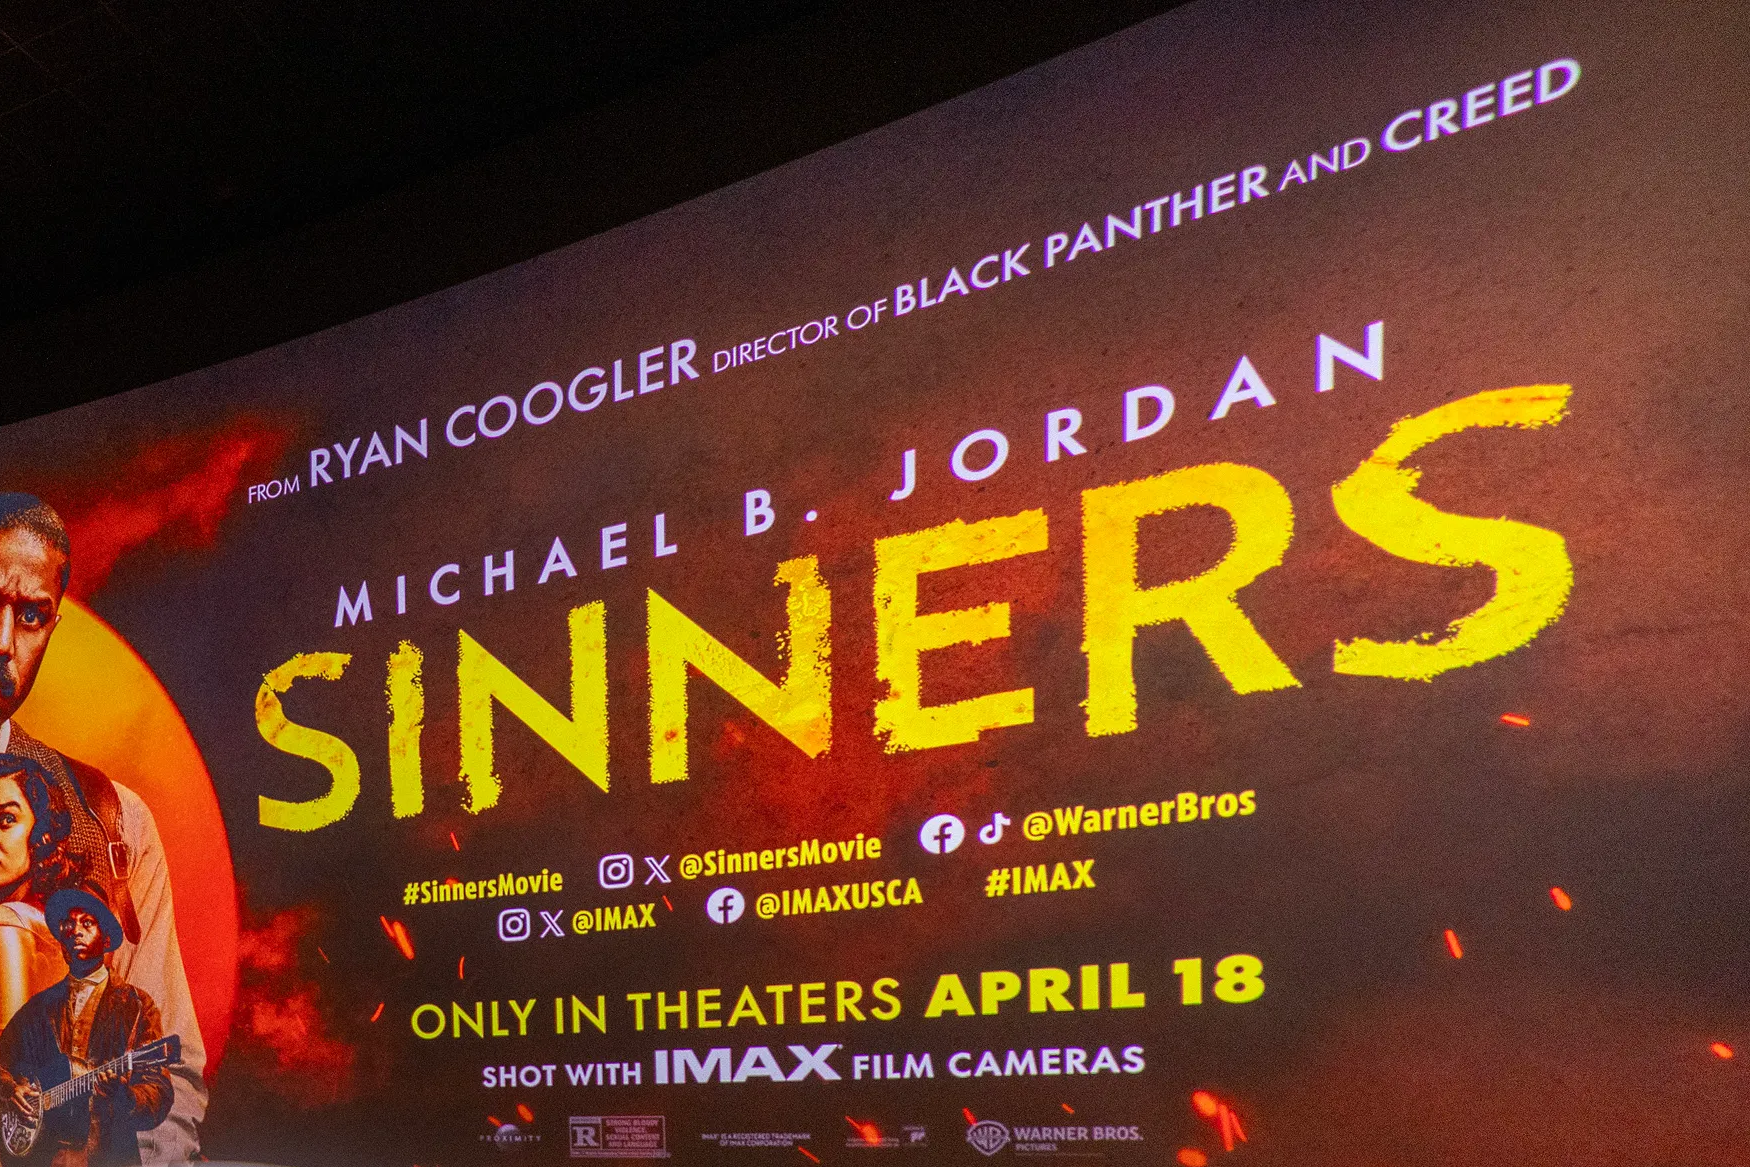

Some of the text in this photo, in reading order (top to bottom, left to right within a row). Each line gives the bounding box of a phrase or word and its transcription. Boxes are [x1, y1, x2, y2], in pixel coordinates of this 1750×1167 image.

[248, 58, 1581, 504] FROM RYAN COOGLER DIRECTOR OF BLACK PANTHER AND CREED
[334, 320, 1384, 628] MICHAEL B. JORDAN
[255, 382, 1576, 834] SINNERS
[1022, 789, 1257, 842] @WarnerBros
[679, 832, 882, 880] @SinnersMovie
[402, 868, 564, 906] #SinnersMovie
[755, 877, 924, 920] @IMAXUSCA
[984, 858, 1096, 898] #IMAX
[572, 902, 657, 935] @IMAX
[411, 953, 1266, 1040] ONLY IN THEATERS APRIL 18
[483, 1065, 557, 1088] SHOT
[565, 1062, 641, 1086] WITH
[853, 1053, 935, 1080] FILM
[948, 1046, 1146, 1078] CAMERAS
[479, 1134, 542, 1143] PROXIMITY
[572, 1126, 600, 1147] R
[1013, 1126, 1144, 1141] WARNER BROS.
[1015, 1143, 1058, 1152] PICTURES
